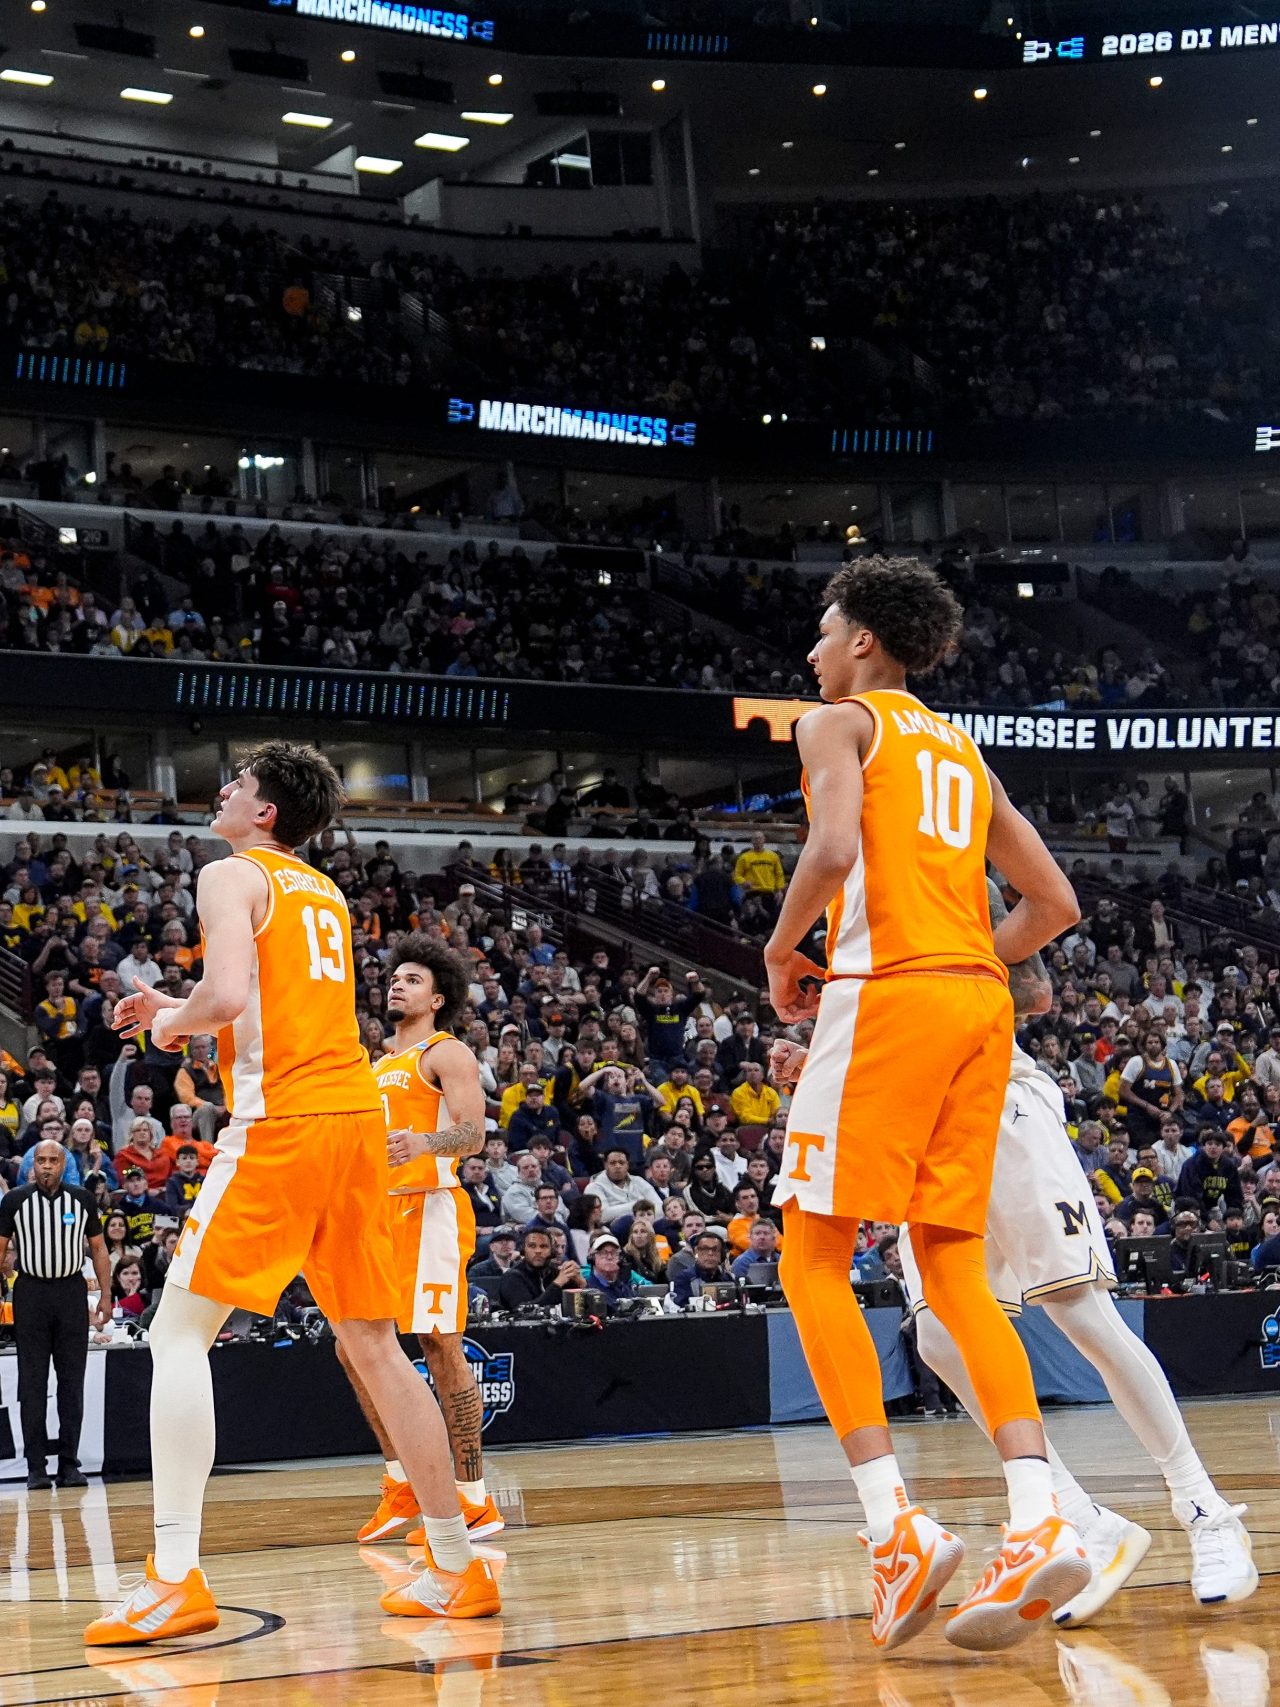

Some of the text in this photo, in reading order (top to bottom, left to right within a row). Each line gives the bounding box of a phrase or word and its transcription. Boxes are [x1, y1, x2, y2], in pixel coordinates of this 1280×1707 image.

[1102, 32, 1173, 56] 2026
[1181, 28, 1213, 50] DI
[891, 709, 964, 753] AMENT
[915, 749, 974, 849] 10
[301, 905, 345, 983] 13
[787, 1131, 826, 1182] T
[1055, 1200, 1092, 1236] M
[423, 1283, 452, 1314] T
